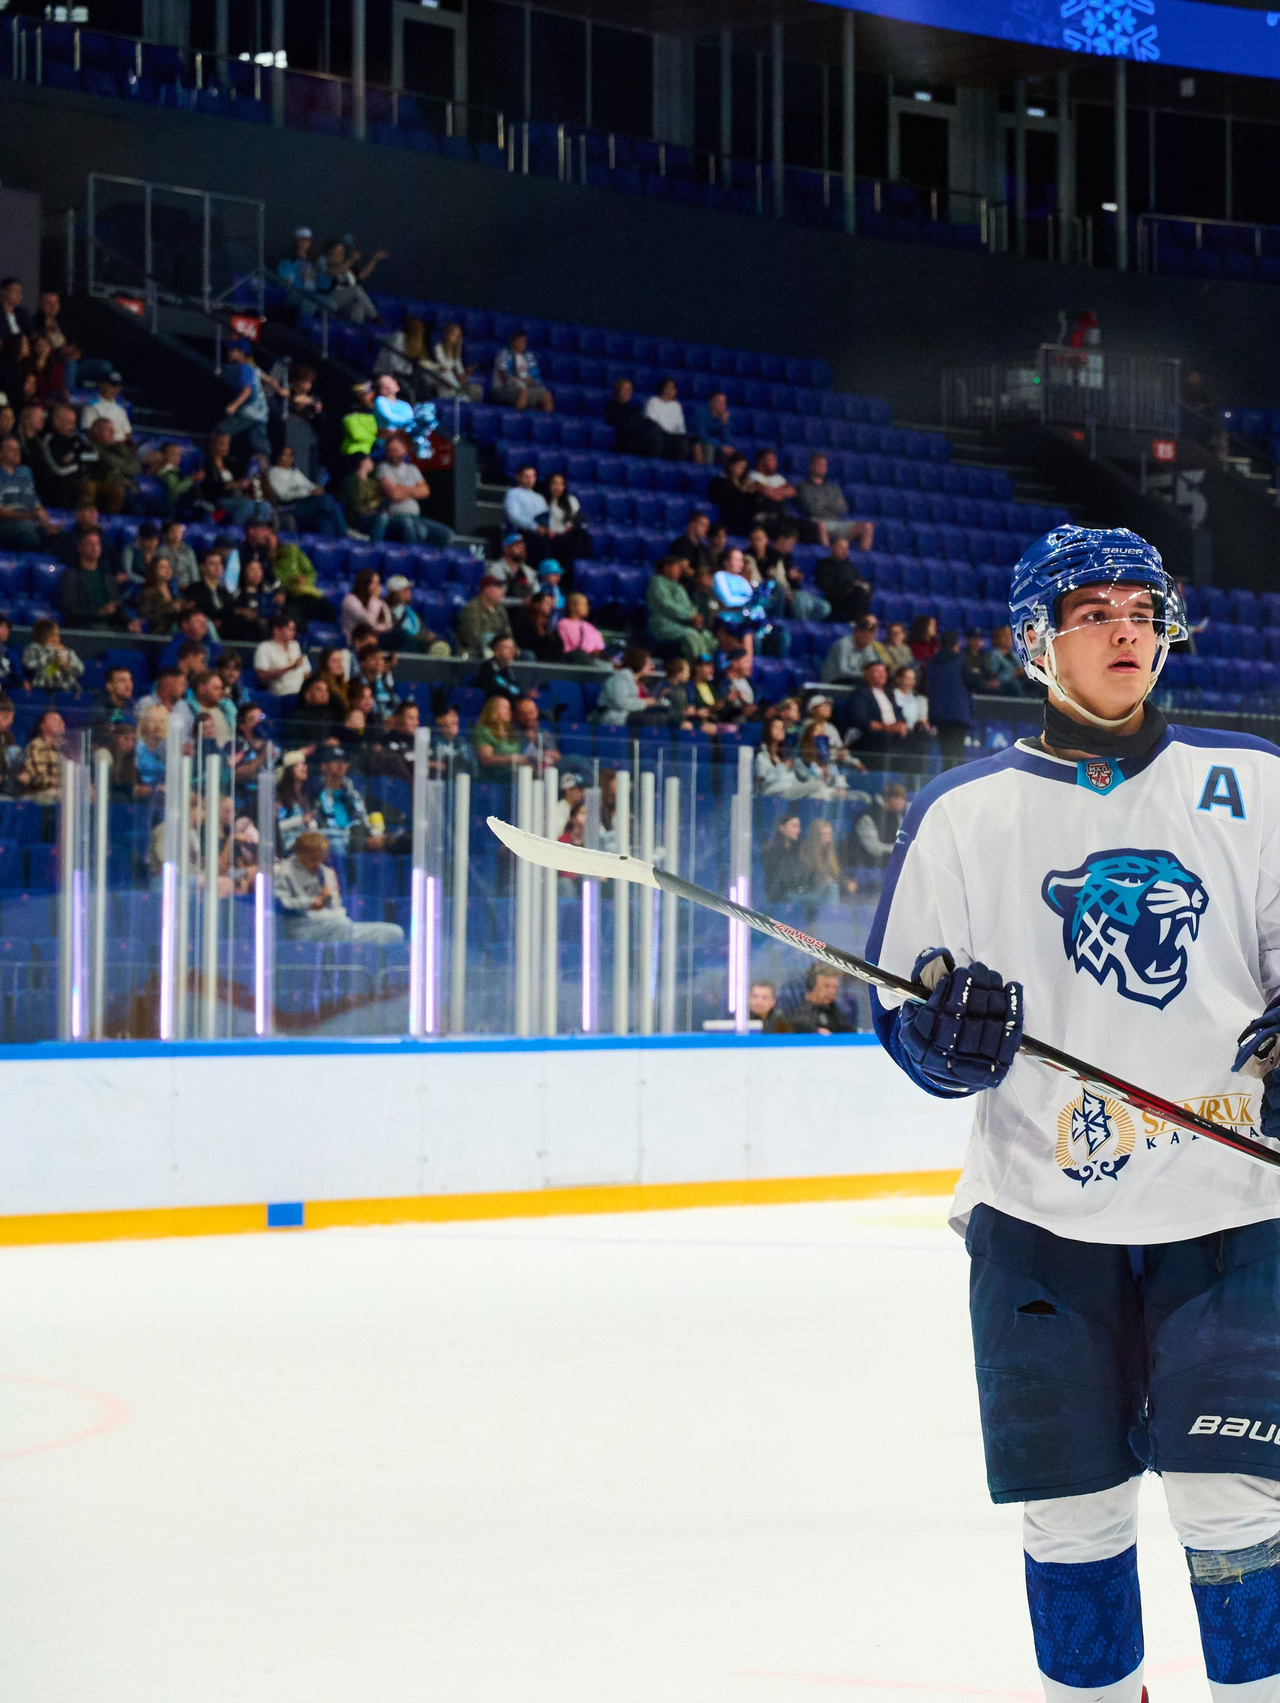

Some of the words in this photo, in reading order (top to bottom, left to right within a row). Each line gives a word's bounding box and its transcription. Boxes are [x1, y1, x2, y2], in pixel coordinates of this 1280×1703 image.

[1101, 547, 1144, 555] BAUER
[1196, 764, 1247, 821] A
[773, 921, 827, 950] SOYUZ
[1146, 1125, 1260, 1150] KANA
